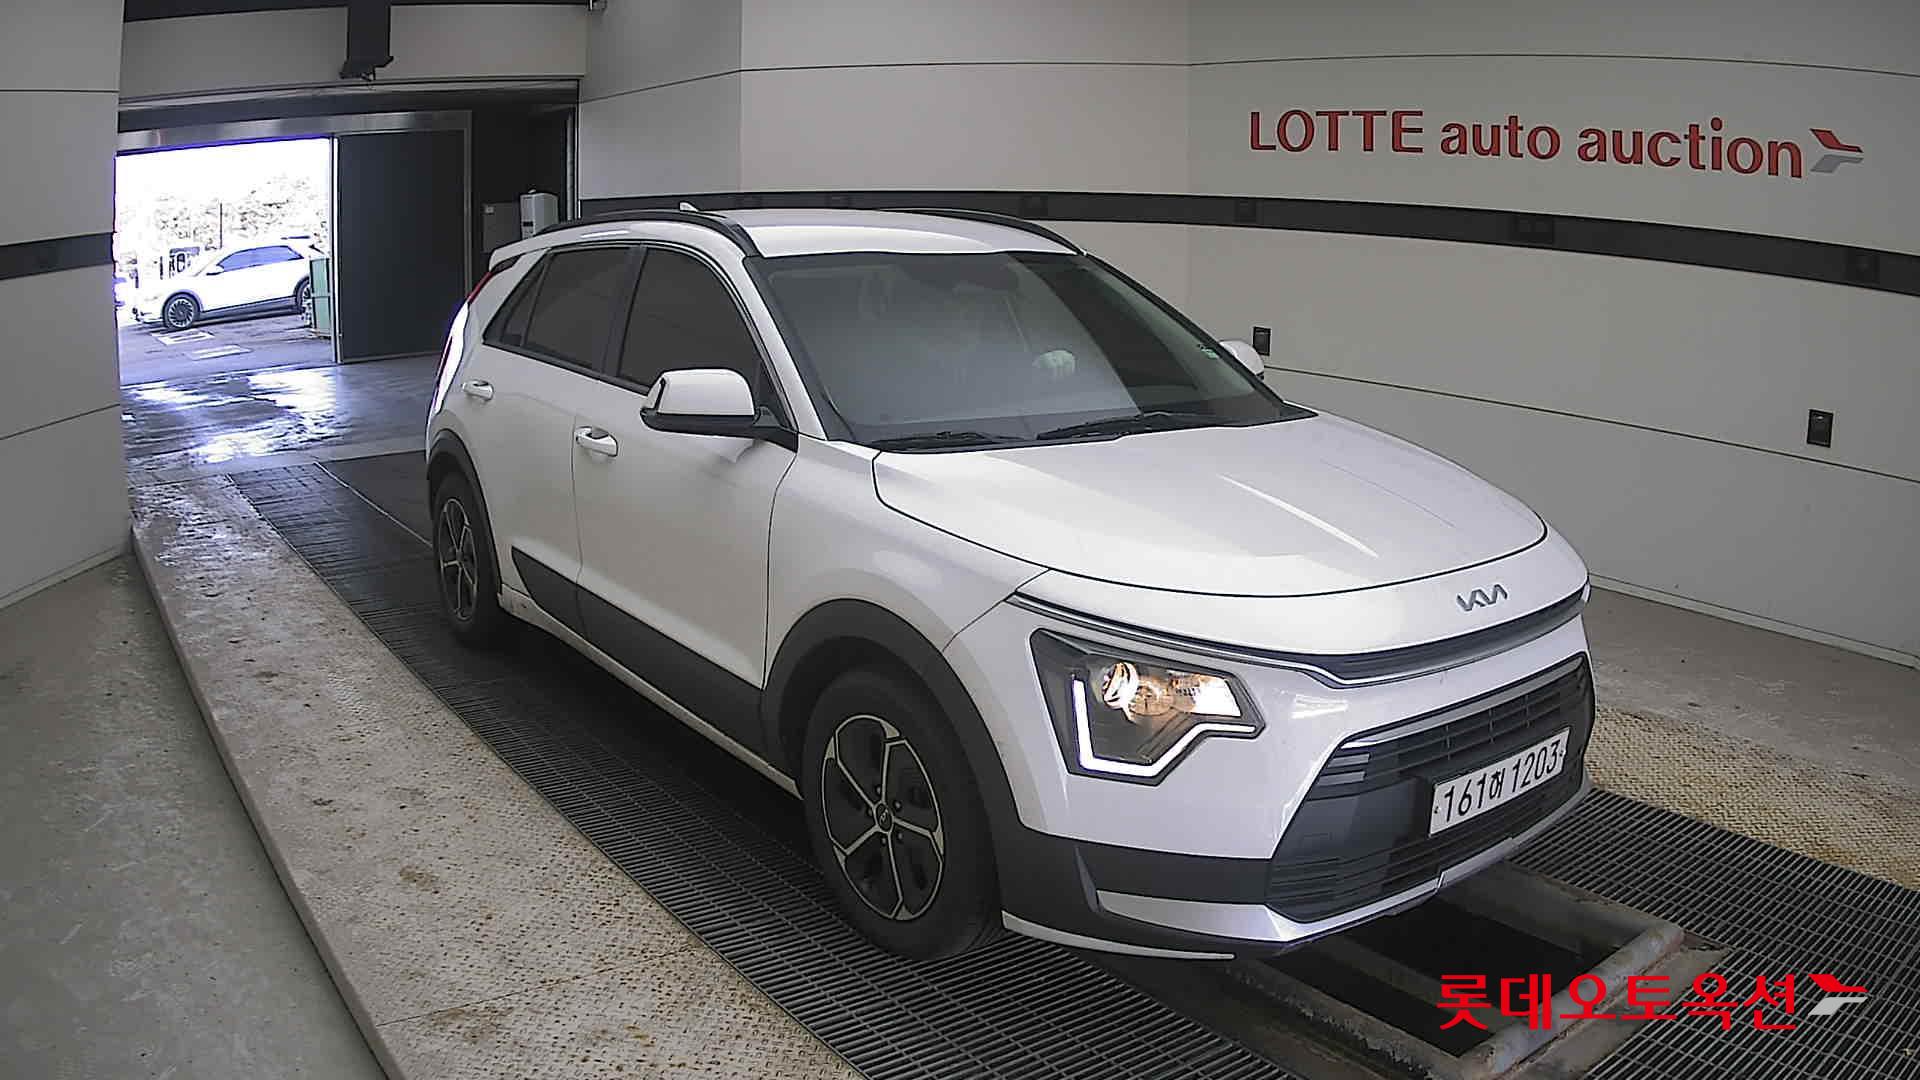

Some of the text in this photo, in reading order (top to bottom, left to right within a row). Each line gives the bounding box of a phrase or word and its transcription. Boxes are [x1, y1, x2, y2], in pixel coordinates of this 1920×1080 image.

[1250, 110, 1803, 178] LOTTE auto auction
[1512, 739, 1561, 793] 1203
